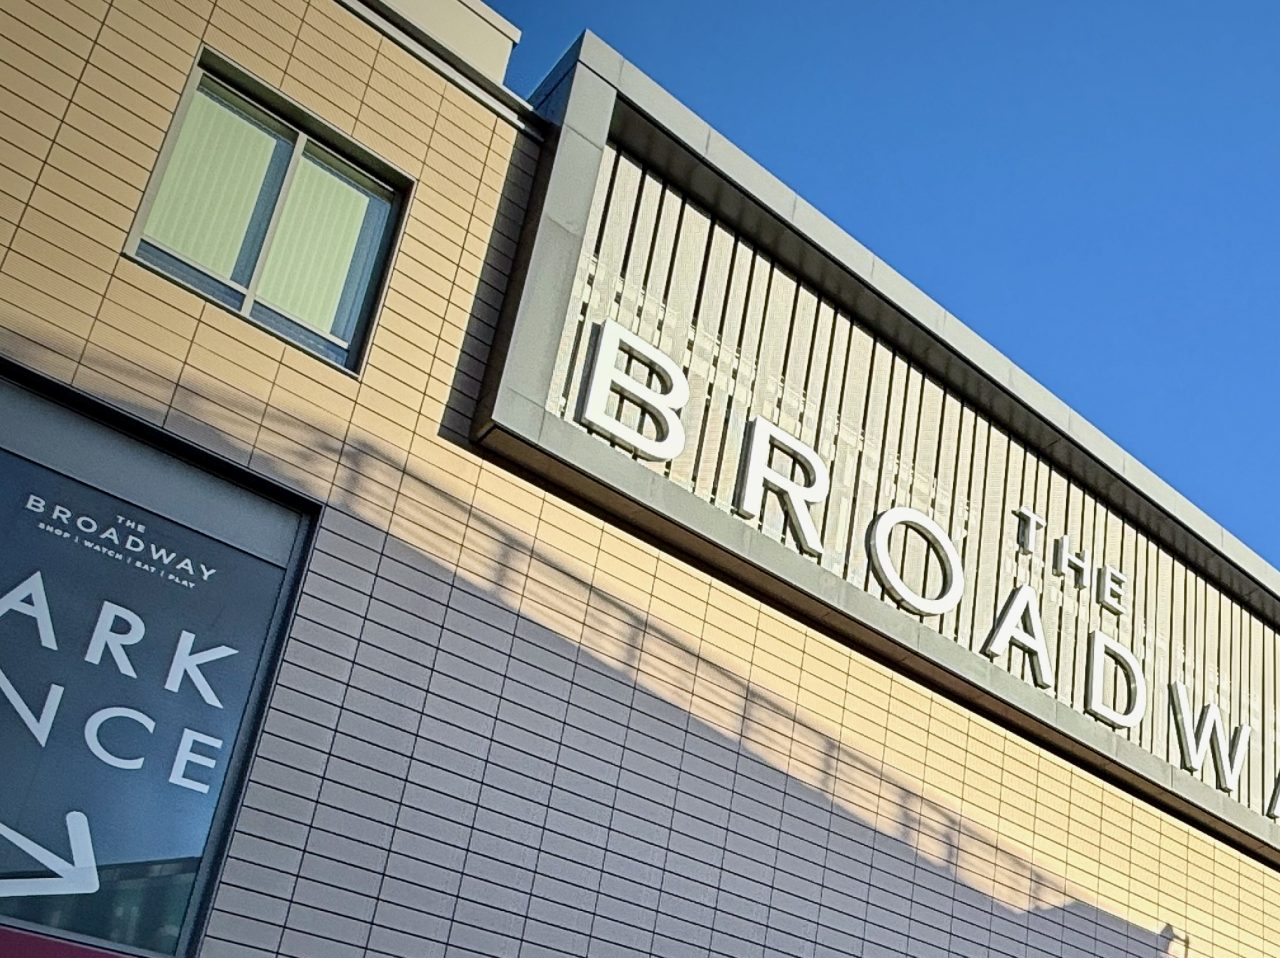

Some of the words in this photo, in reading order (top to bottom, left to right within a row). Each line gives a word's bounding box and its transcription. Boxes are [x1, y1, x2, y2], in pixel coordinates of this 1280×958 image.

[25, 494, 217, 582] BROADWAY
[38, 522, 71, 538] SHOP
[84, 540, 123, 560] WATCH
[135, 560, 157, 573] EAT
[168, 573, 196, 589] PLAY
[116, 514, 147, 533] THE
[1011, 505, 1131, 616] THE
